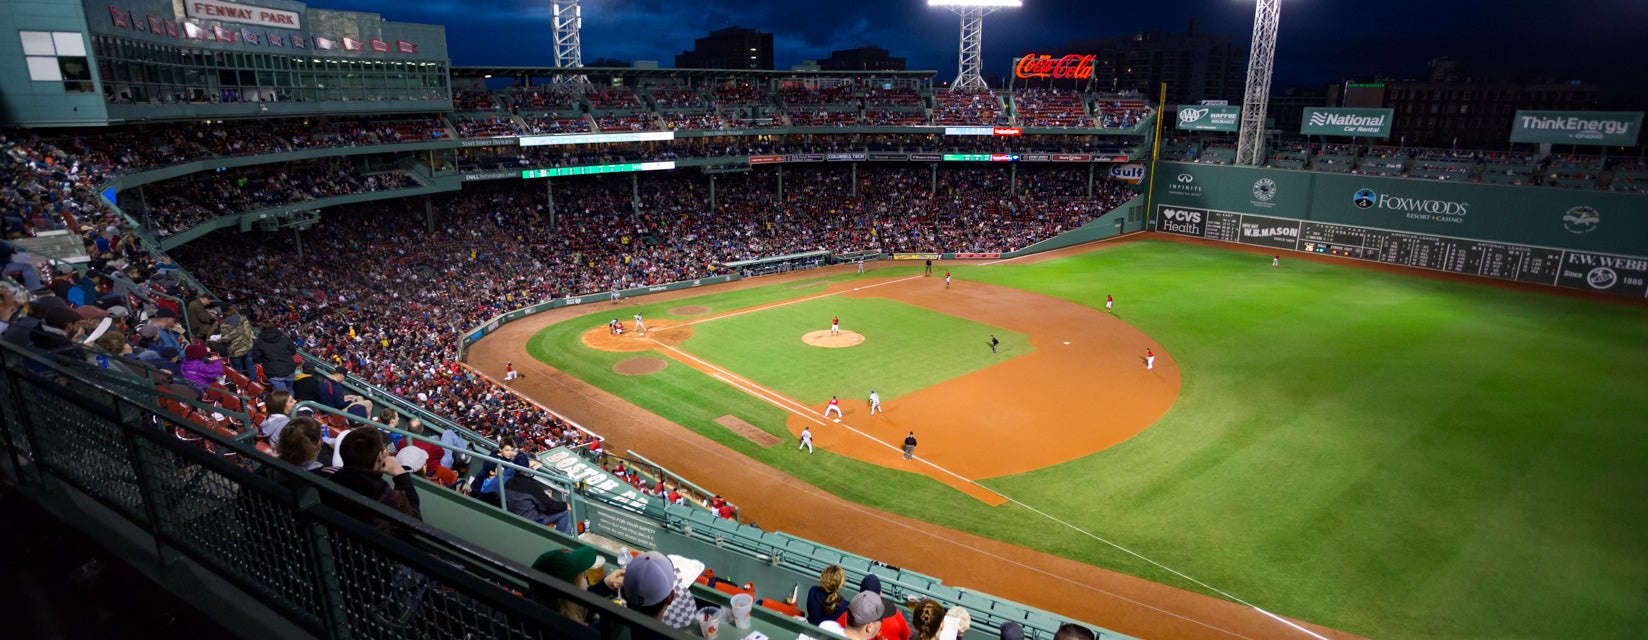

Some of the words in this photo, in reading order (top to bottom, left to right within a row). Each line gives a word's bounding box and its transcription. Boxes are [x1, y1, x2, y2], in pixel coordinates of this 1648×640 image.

[194, 2, 252, 20] FENWAY
[259, 11, 294, 25] PARK
[1016, 53, 1096, 79] Coca-Cola
[1522, 116, 1629, 134] ThinkEnergy
[1111, 165, 1144, 177] Gulf
[1378, 194, 1467, 216] FOXWOODS
[1175, 210, 1201, 223] CVS
[1436, 215, 1463, 223] CASINO
[1163, 219, 1200, 235] Health
[1600, 256, 1648, 271] WEBB
[1563, 270, 1583, 278] Since
[626, 521, 639, 529] YOUR
[639, 525, 656, 535] SAFETY
